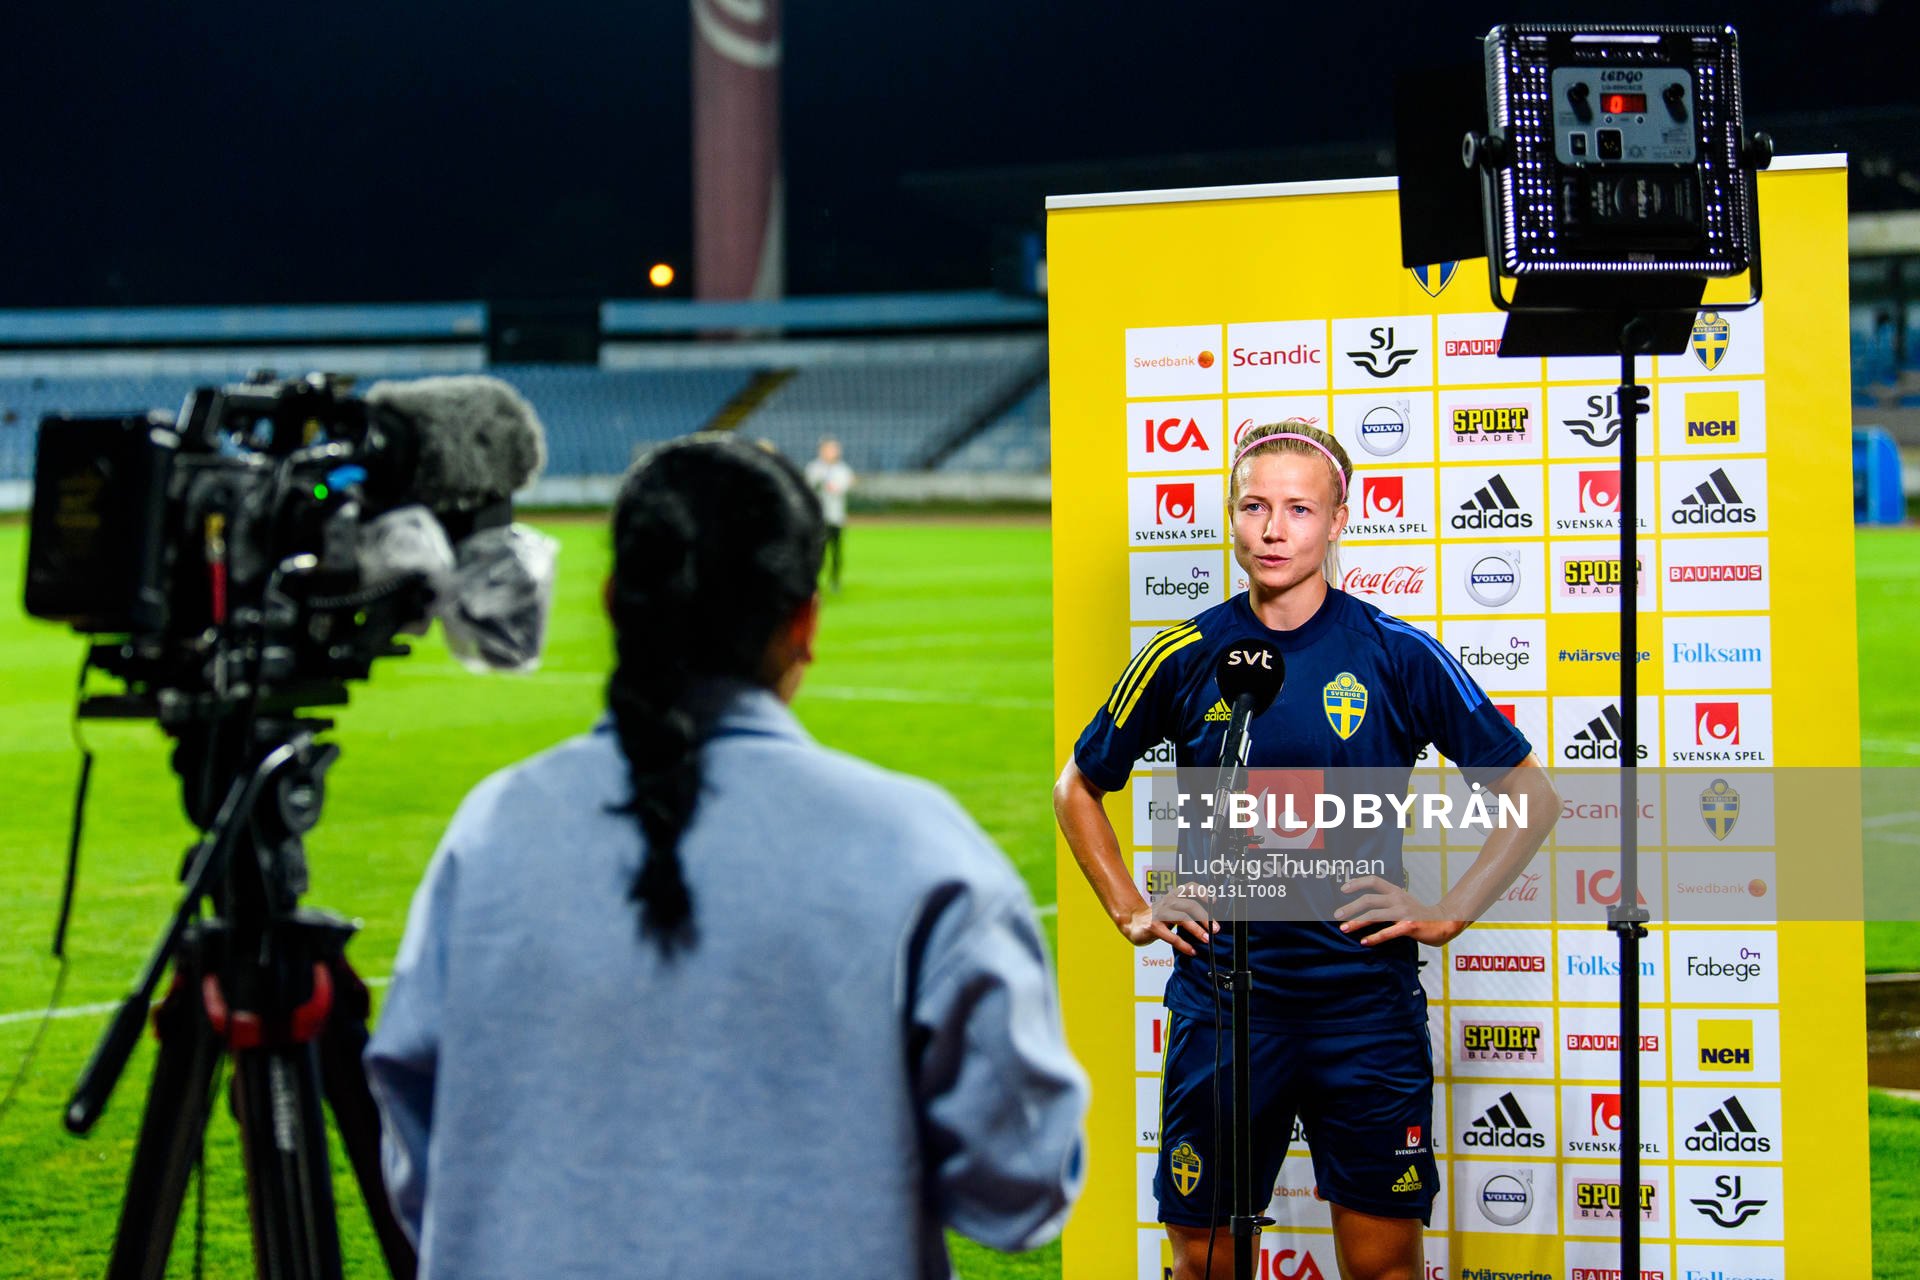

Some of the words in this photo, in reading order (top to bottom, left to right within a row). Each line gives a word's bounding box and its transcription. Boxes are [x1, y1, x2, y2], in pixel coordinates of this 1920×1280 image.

[1369, 327, 1394, 350] SJ
[1445, 339, 1503, 356] BAUH
[1133, 356, 1196, 369] Swedbank
[1232, 344, 1321, 367] Scandic
[1587, 395, 1613, 419] SJ
[1363, 424, 1404, 433] VOLVO
[1453, 407, 1529, 434] SPORT
[1145, 417, 1210, 453] ICA
[1457, 433, 1526, 443] BLADET
[1450, 508, 1533, 530] adidas
[1671, 503, 1757, 524] adidas
[1135, 530, 1187, 541] SVENSKA
[1190, 528, 1217, 539] SPEL
[1342, 524, 1395, 536] SVENSKA
[1399, 523, 1428, 534] SPEL
[1557, 519, 1613, 530] SVENSKA
[1472, 574, 1513, 584] VOLVO
[1669, 564, 1762, 582] BAUHAUS
[1145, 577, 1210, 600] Fabege
[1227, 649, 1273, 670] svt
[1460, 646, 1530, 670] Fabege
[1671, 642, 1763, 664] Folksam
[1330, 690, 1362, 698] SVERIGE
[1564, 738, 1649, 760] adids
[1672, 751, 1732, 762] SVENSKA
[1735, 751, 1766, 761] SPEL
[1561, 799, 1656, 820] Scanic
[1676, 882, 1745, 894] Swedbank
[1455, 955, 1545, 972] BAUHAUS
[1567, 955, 1656, 976] Folksm
[1688, 956, 1761, 982] Fabege
[1464, 1024, 1541, 1052] SPORT
[1567, 1034, 1659, 1052] BAUHS
[1468, 1051, 1538, 1061] BLADET
[1462, 1127, 1546, 1149] adidas
[1684, 1131, 1771, 1153] adidas
[1391, 1181, 1423, 1193] adidas
[1485, 1192, 1525, 1202] VOLVO
[1577, 1183, 1656, 1211] SPOT
[1715, 1174, 1741, 1200] SJ
[1582, 1209, 1652, 1219] BLAT
[1260, 1249, 1325, 1280] ICA
[1572, 1268, 1664, 1280] BAUHUS
